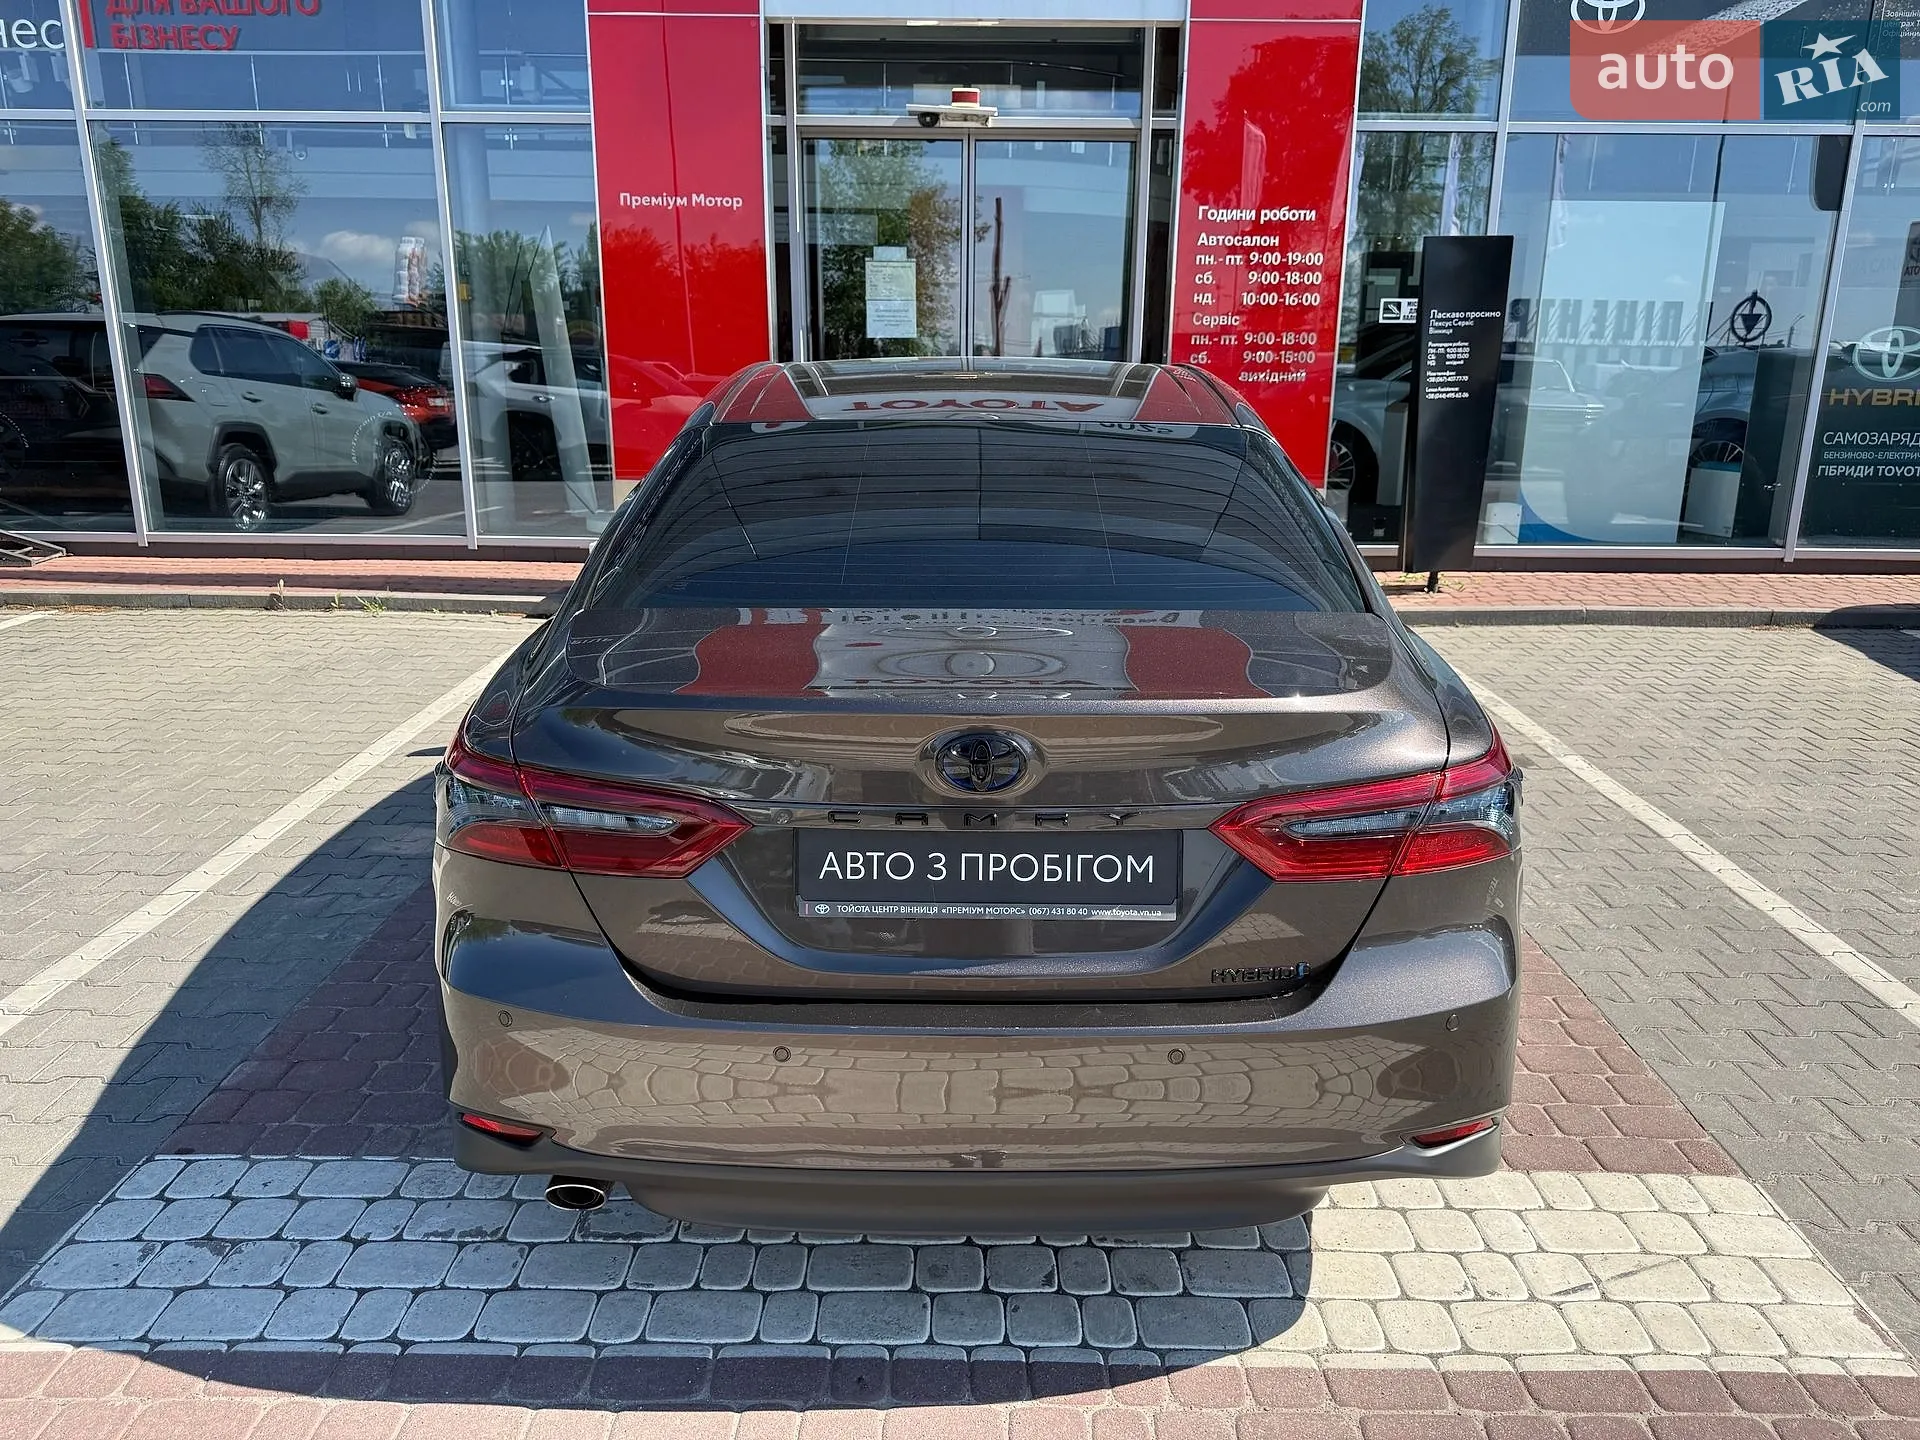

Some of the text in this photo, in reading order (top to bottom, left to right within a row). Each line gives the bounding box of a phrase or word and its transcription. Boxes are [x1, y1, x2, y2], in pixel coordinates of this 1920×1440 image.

[111, 23, 239, 50] БІЗНЕСУ
[619, 192, 743, 211] Преміум Мотор
[1198, 205, 1317, 224] Години роботи
[1196, 232, 1280, 247] Автосалон
[1249, 251, 1324, 266] 9:00-19:00
[1194, 271, 1323, 285] сб. 9:00-18:00
[1193, 292, 1321, 306] нд. 10:00-16:00
[1192, 312, 1240, 328] Сервіс
[1429, 308, 1465, 319] Ласкаво
[1465, 310, 1501, 320] просимо
[1243, 331, 1318, 346] 9:00-18:00
[1189, 350, 1316, 365] сб. 9:00-15:00
[1238, 368, 1307, 383] вихідний
[1817, 465, 1875, 478] ГІБРИДИ
[827, 810, 1142, 827] CAMRY
[818, 850, 916, 881] АВТО
[960, 852, 1154, 884] ПРОБІГОМ
[836, 903, 1162, 918] ТОЙОТА ЦЕНТР ВІННИЦЯ «ПРЕМІУМ МОТОРС» (067) 431 80 40 www.toyota.vn.ua
